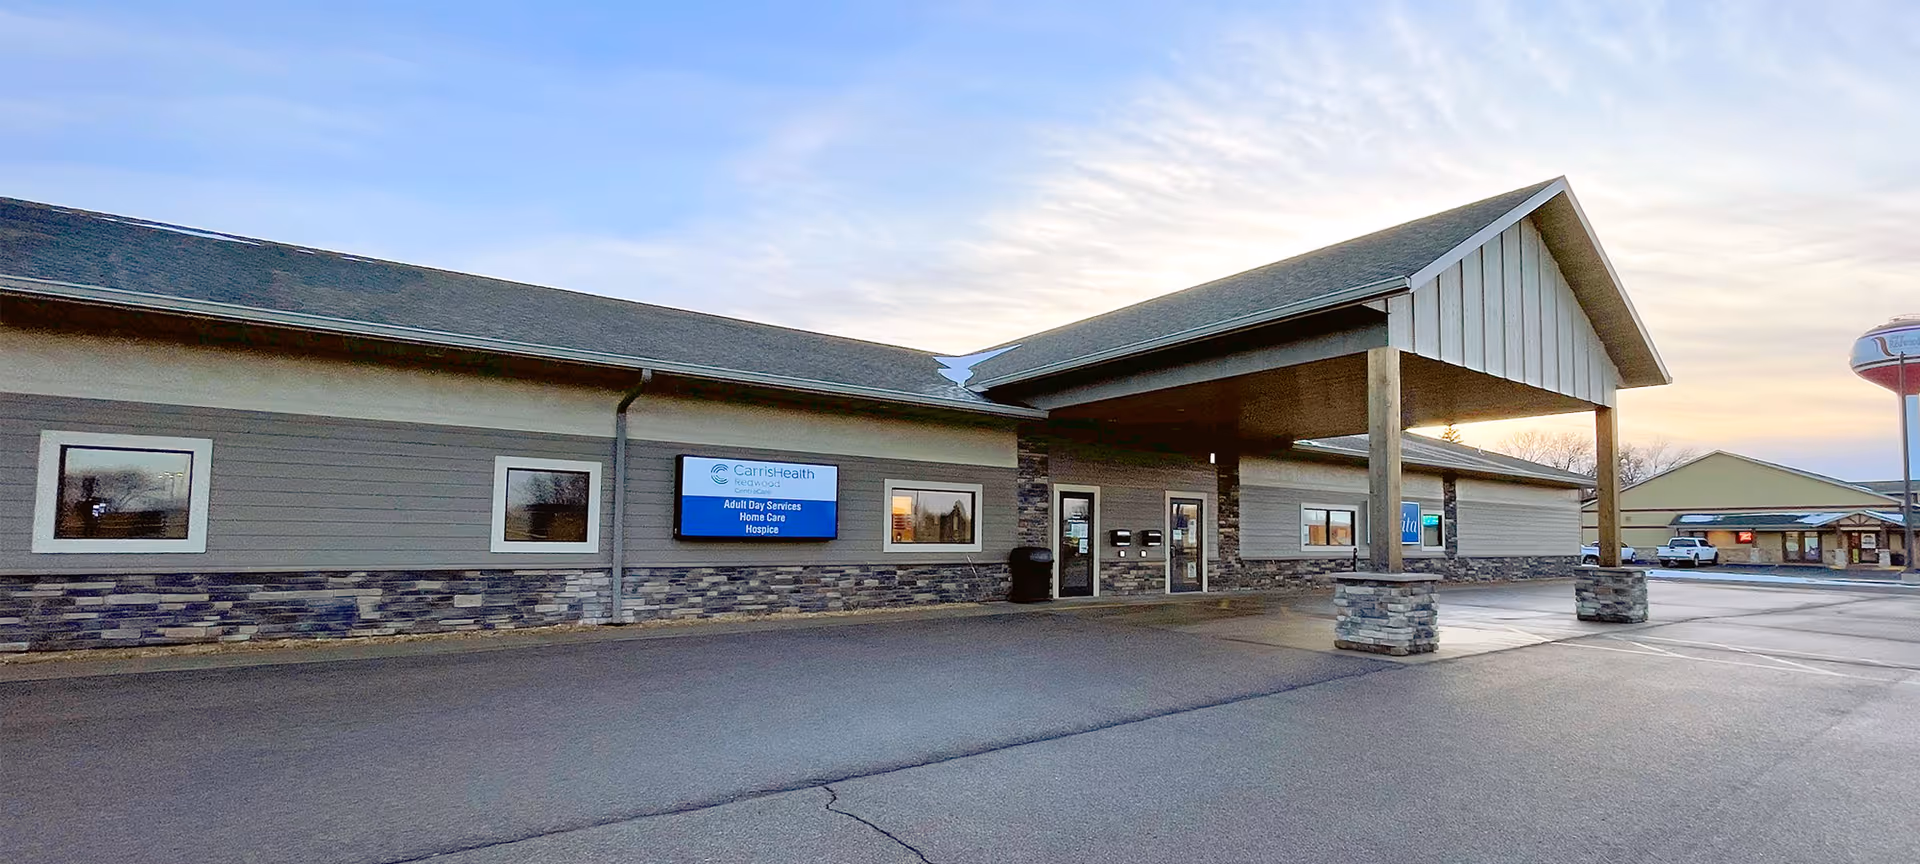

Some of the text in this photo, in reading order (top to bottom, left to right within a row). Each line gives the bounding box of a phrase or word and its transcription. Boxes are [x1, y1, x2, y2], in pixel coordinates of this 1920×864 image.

[734, 464, 815, 480] CarrisHealth
[734, 479, 781, 488] Redwood
[723, 499, 802, 512] Adult Day Services
[739, 512, 786, 523] Home Care
[1401, 512, 1417, 533] ita
[745, 524, 779, 536] Hospice
